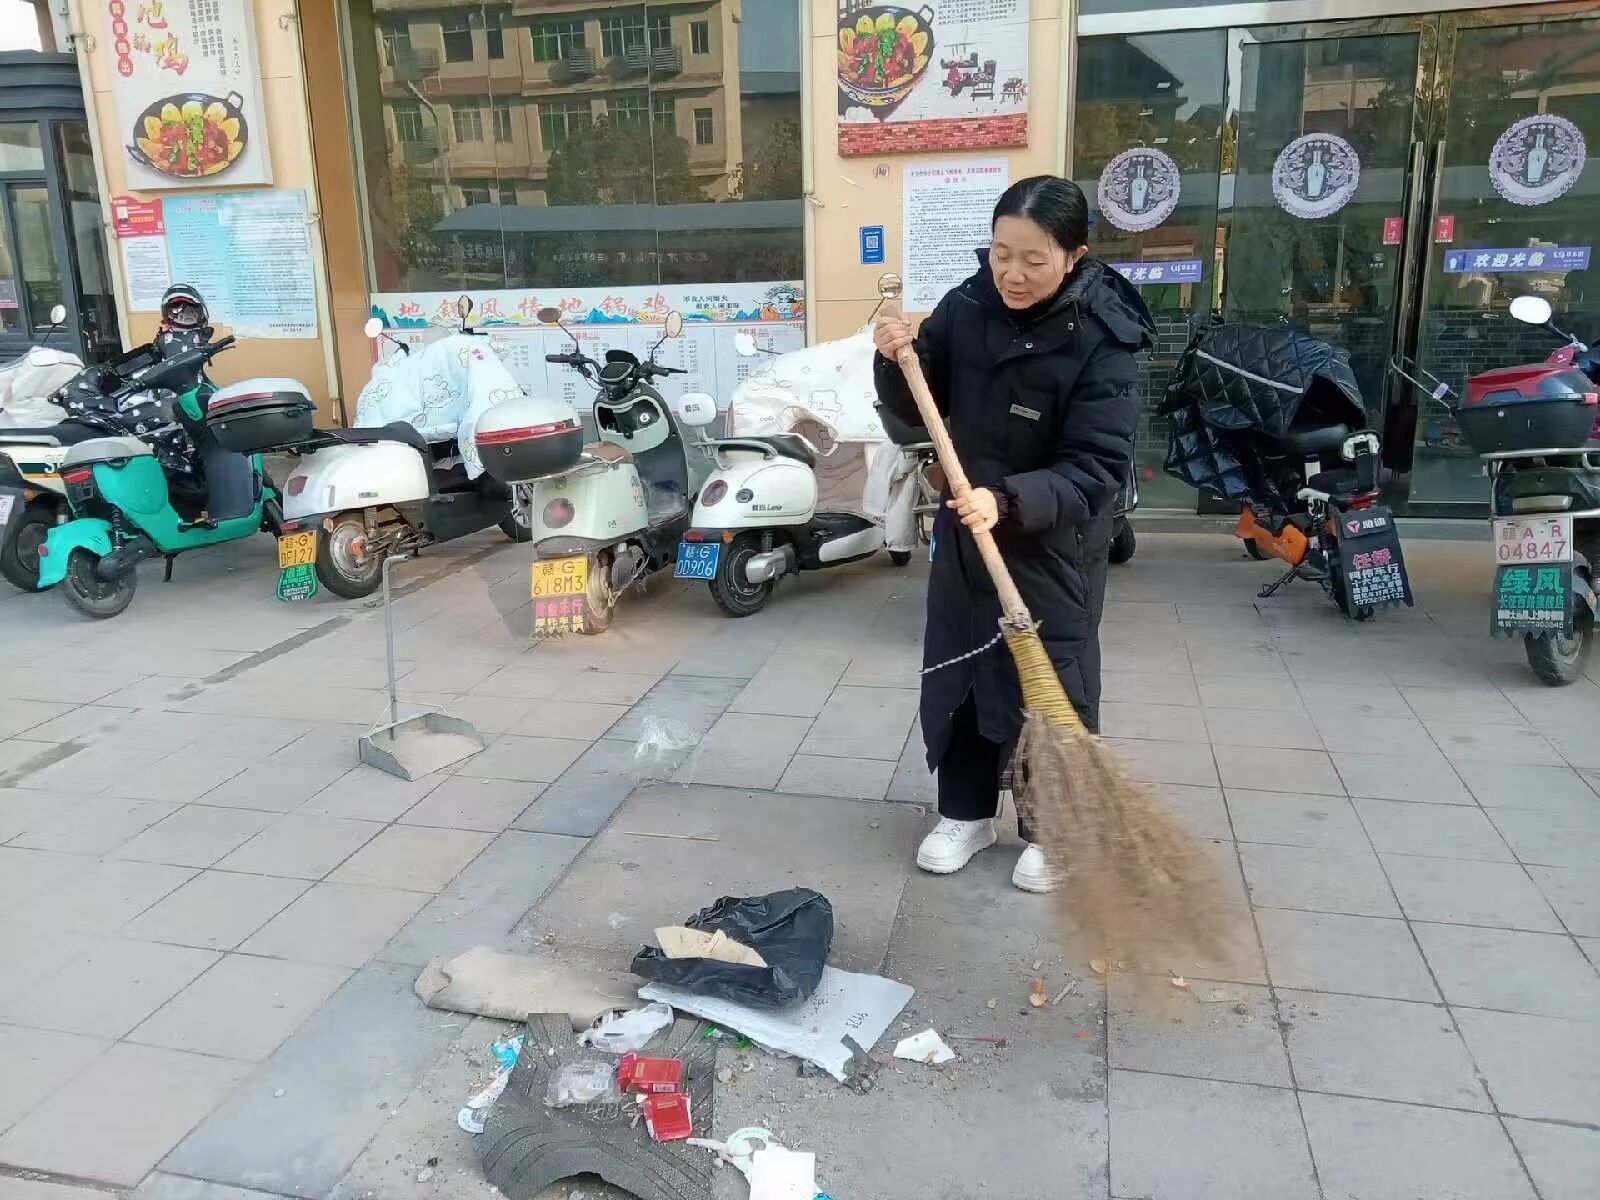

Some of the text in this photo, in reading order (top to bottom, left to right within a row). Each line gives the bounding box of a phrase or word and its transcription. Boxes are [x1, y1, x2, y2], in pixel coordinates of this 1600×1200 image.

[1473, 251, 1545, 268] 欢迎光临
[281, 548, 313, 567] DF127
[1499, 541, 1566, 560] 04847
[677, 560, 713, 576] 00906
[533, 575, 583, 595] 618M3
